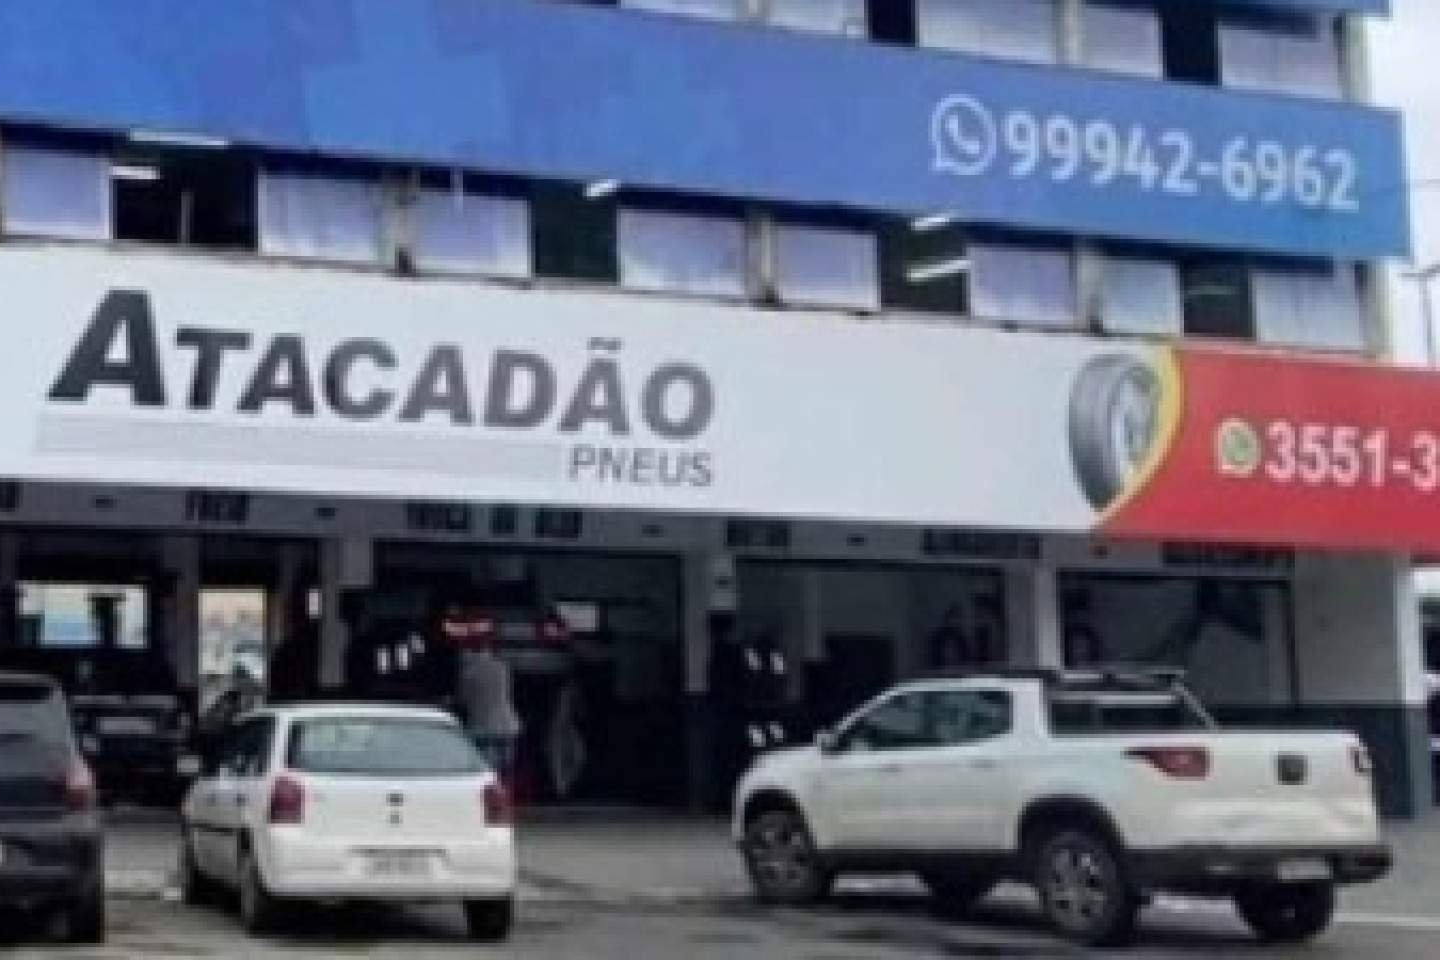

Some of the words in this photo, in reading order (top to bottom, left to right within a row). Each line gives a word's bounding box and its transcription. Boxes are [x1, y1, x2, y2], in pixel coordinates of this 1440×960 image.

[1004, 109, 1359, 212] 99942-6962
[47, 288, 715, 441] ATACADÃO
[569, 446, 714, 488] PNEUS
